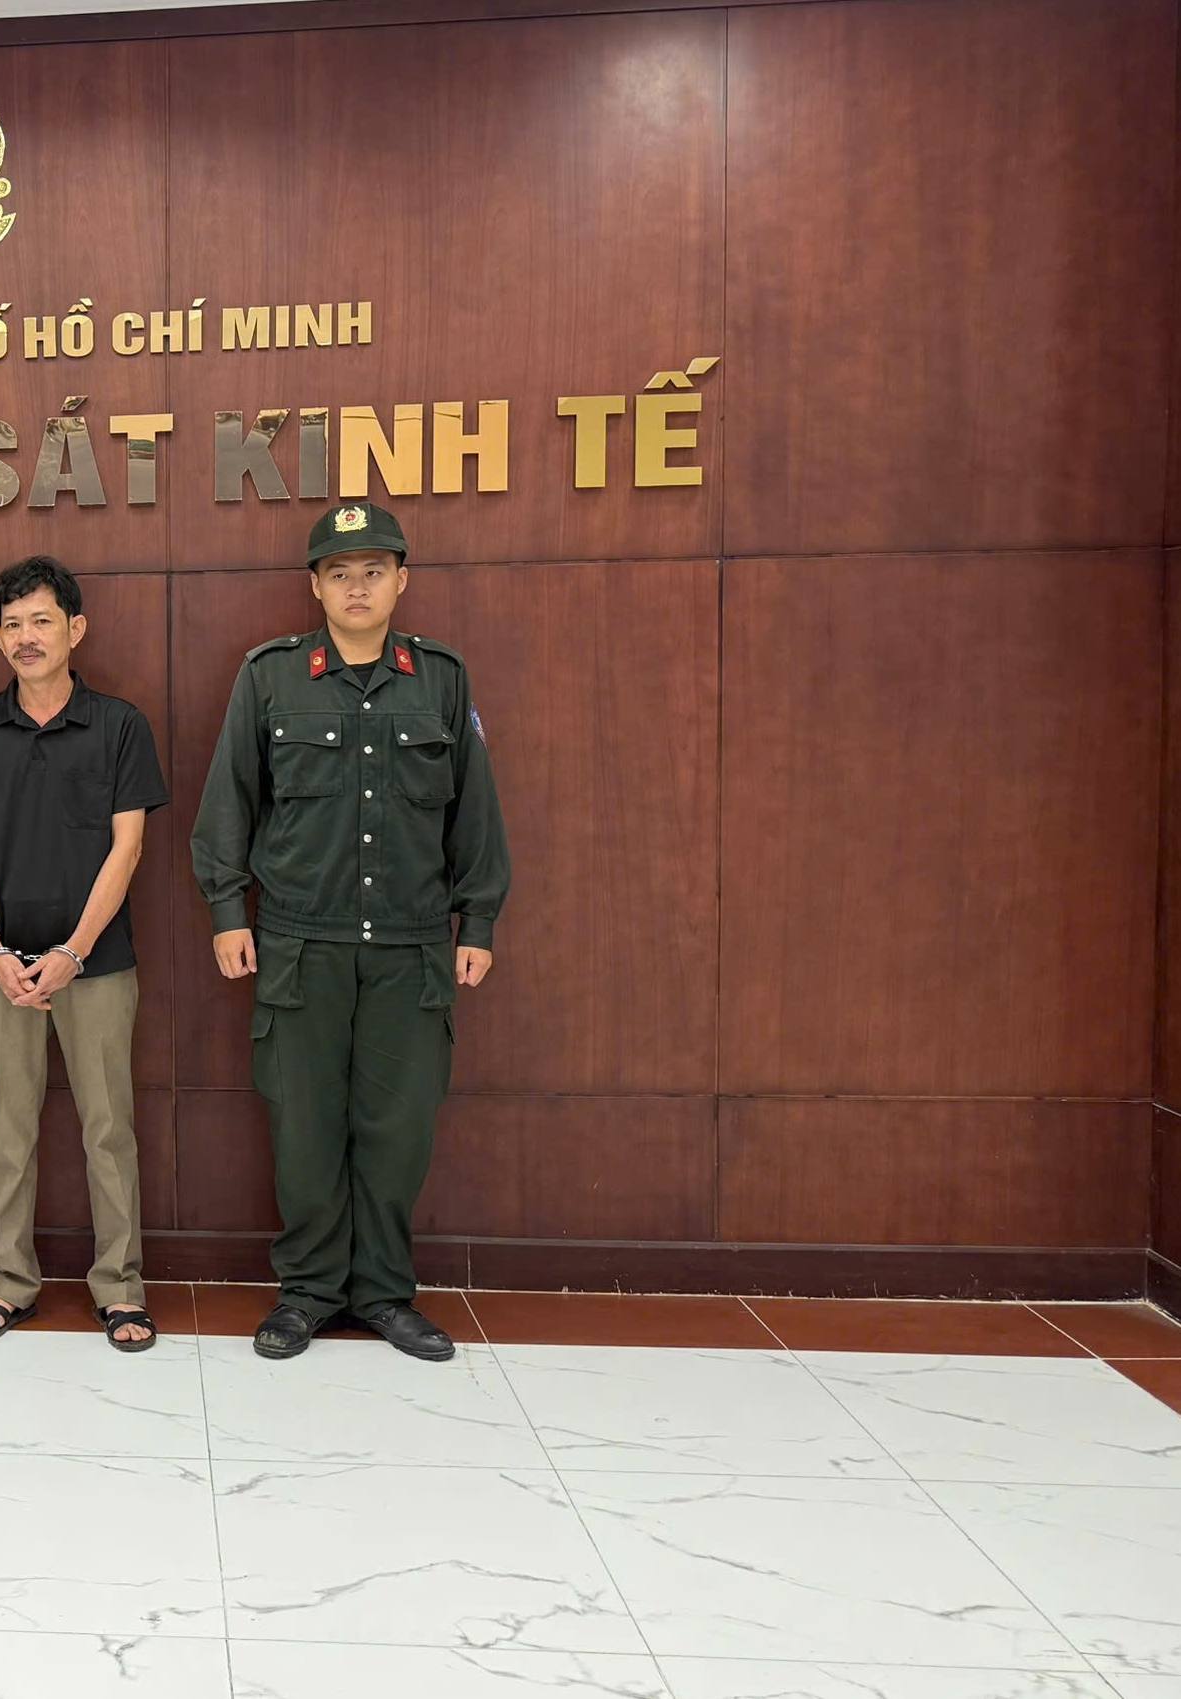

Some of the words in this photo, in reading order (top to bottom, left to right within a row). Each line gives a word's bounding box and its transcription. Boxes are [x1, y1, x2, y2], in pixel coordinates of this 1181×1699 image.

[23, 297, 95, 360] HỒ
[111, 297, 206, 356] CHÍ
[221, 301, 373, 351] MINH
[214, 399, 510, 503] KINH
[557, 356, 721, 490] TẾ
